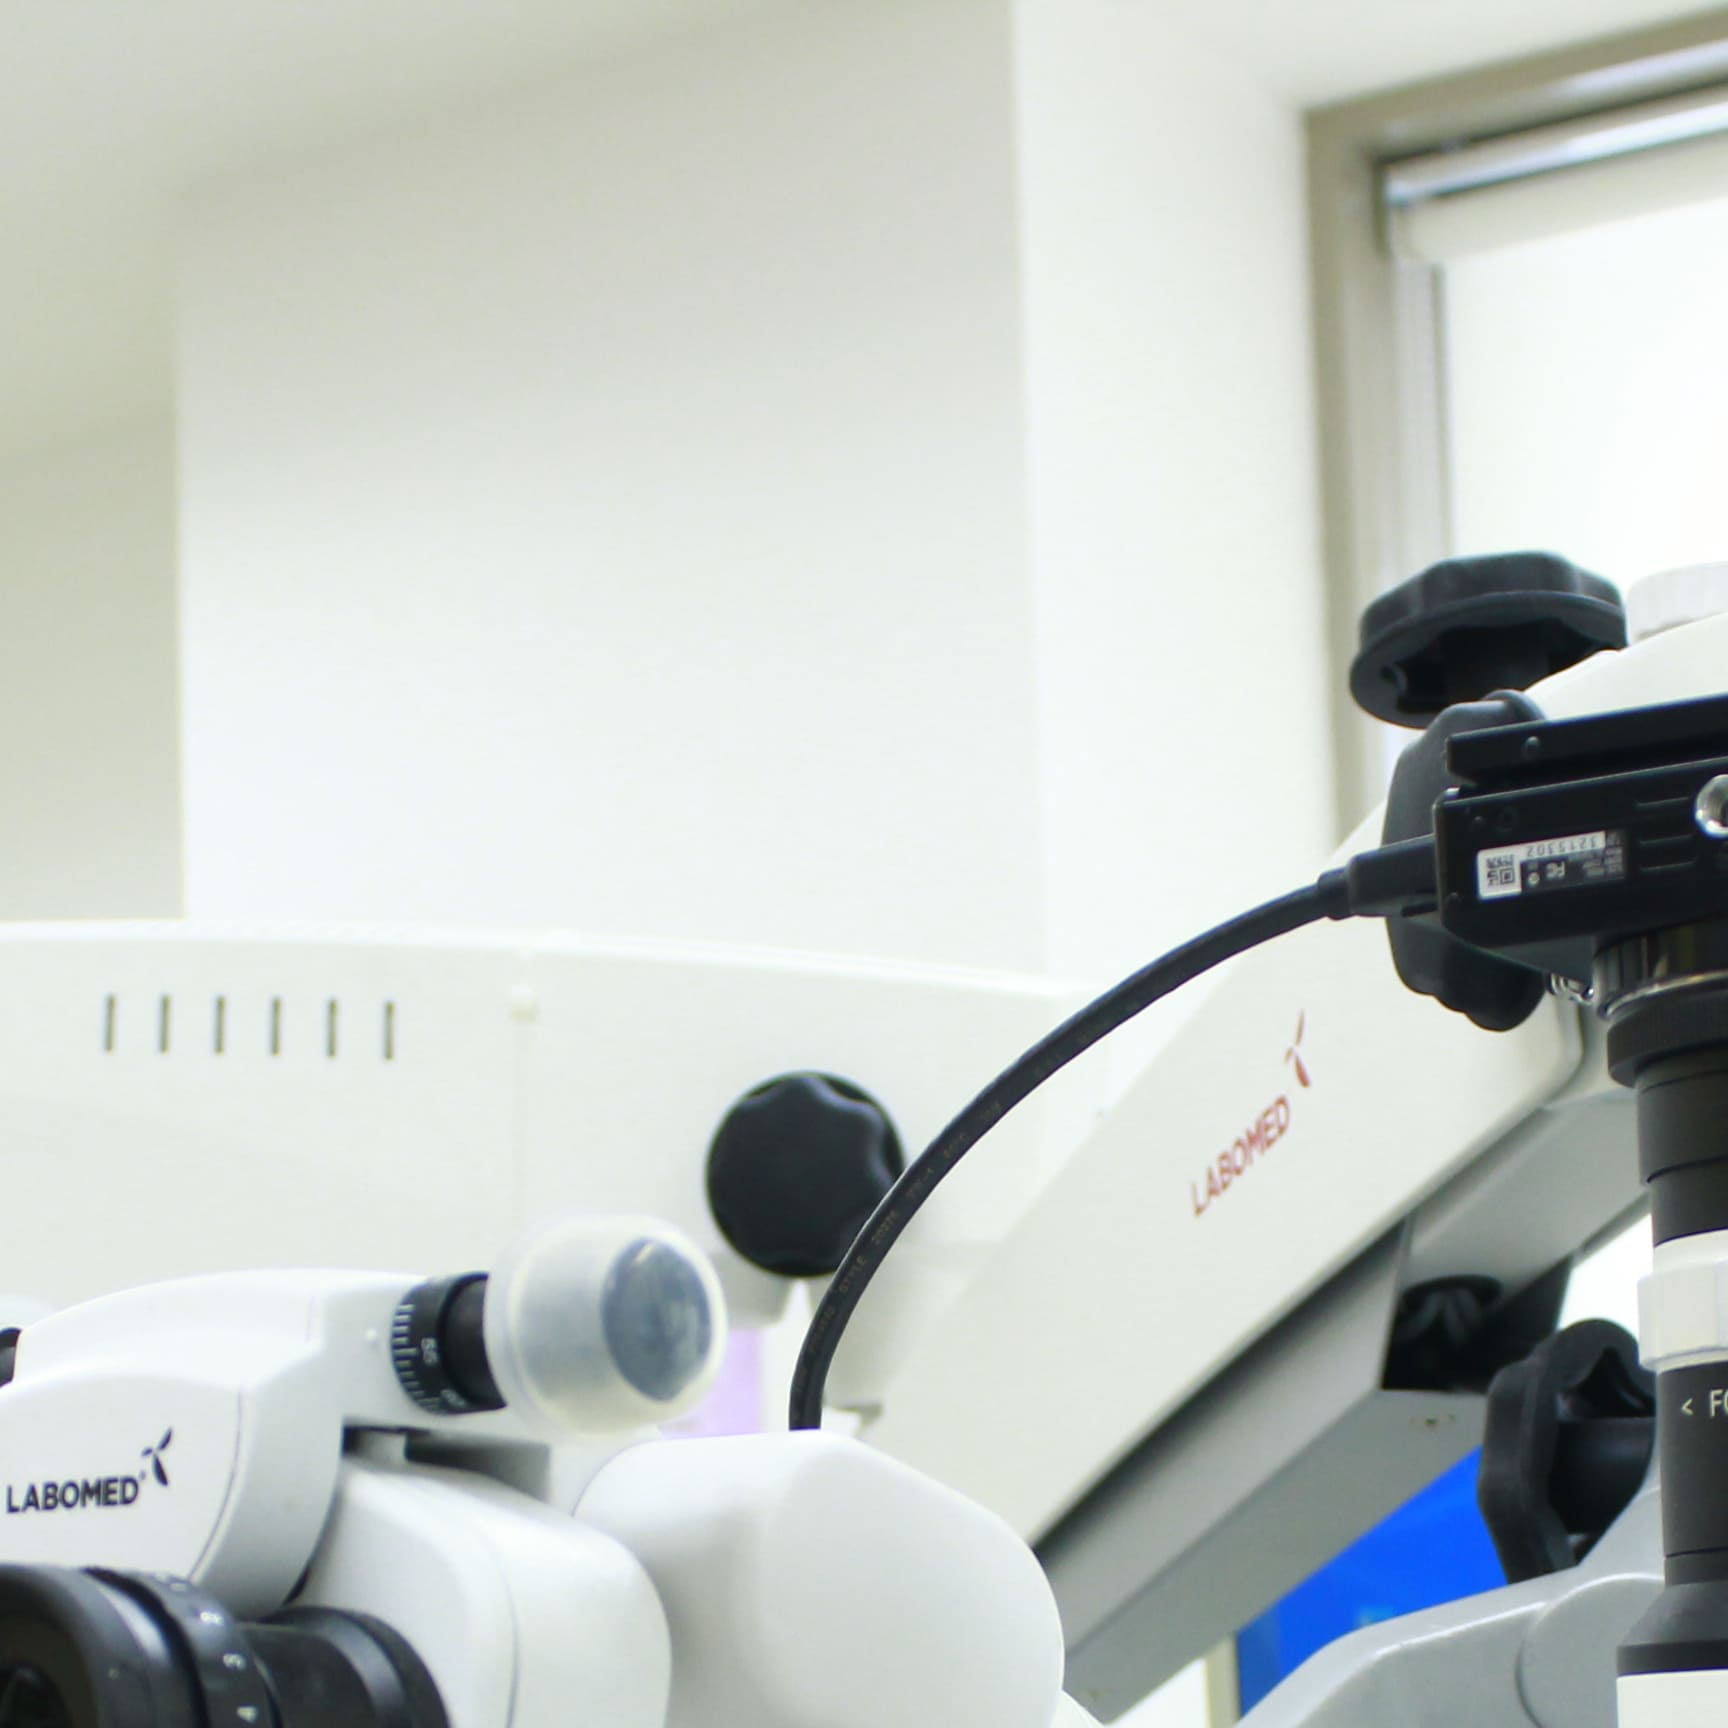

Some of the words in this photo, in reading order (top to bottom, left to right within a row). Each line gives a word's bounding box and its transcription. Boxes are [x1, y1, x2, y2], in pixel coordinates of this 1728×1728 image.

[1192, 1095, 1290, 1216] LABOMED
[7, 1475, 140, 1514] LABOMED
[237, 1705, 259, 1724] 4
